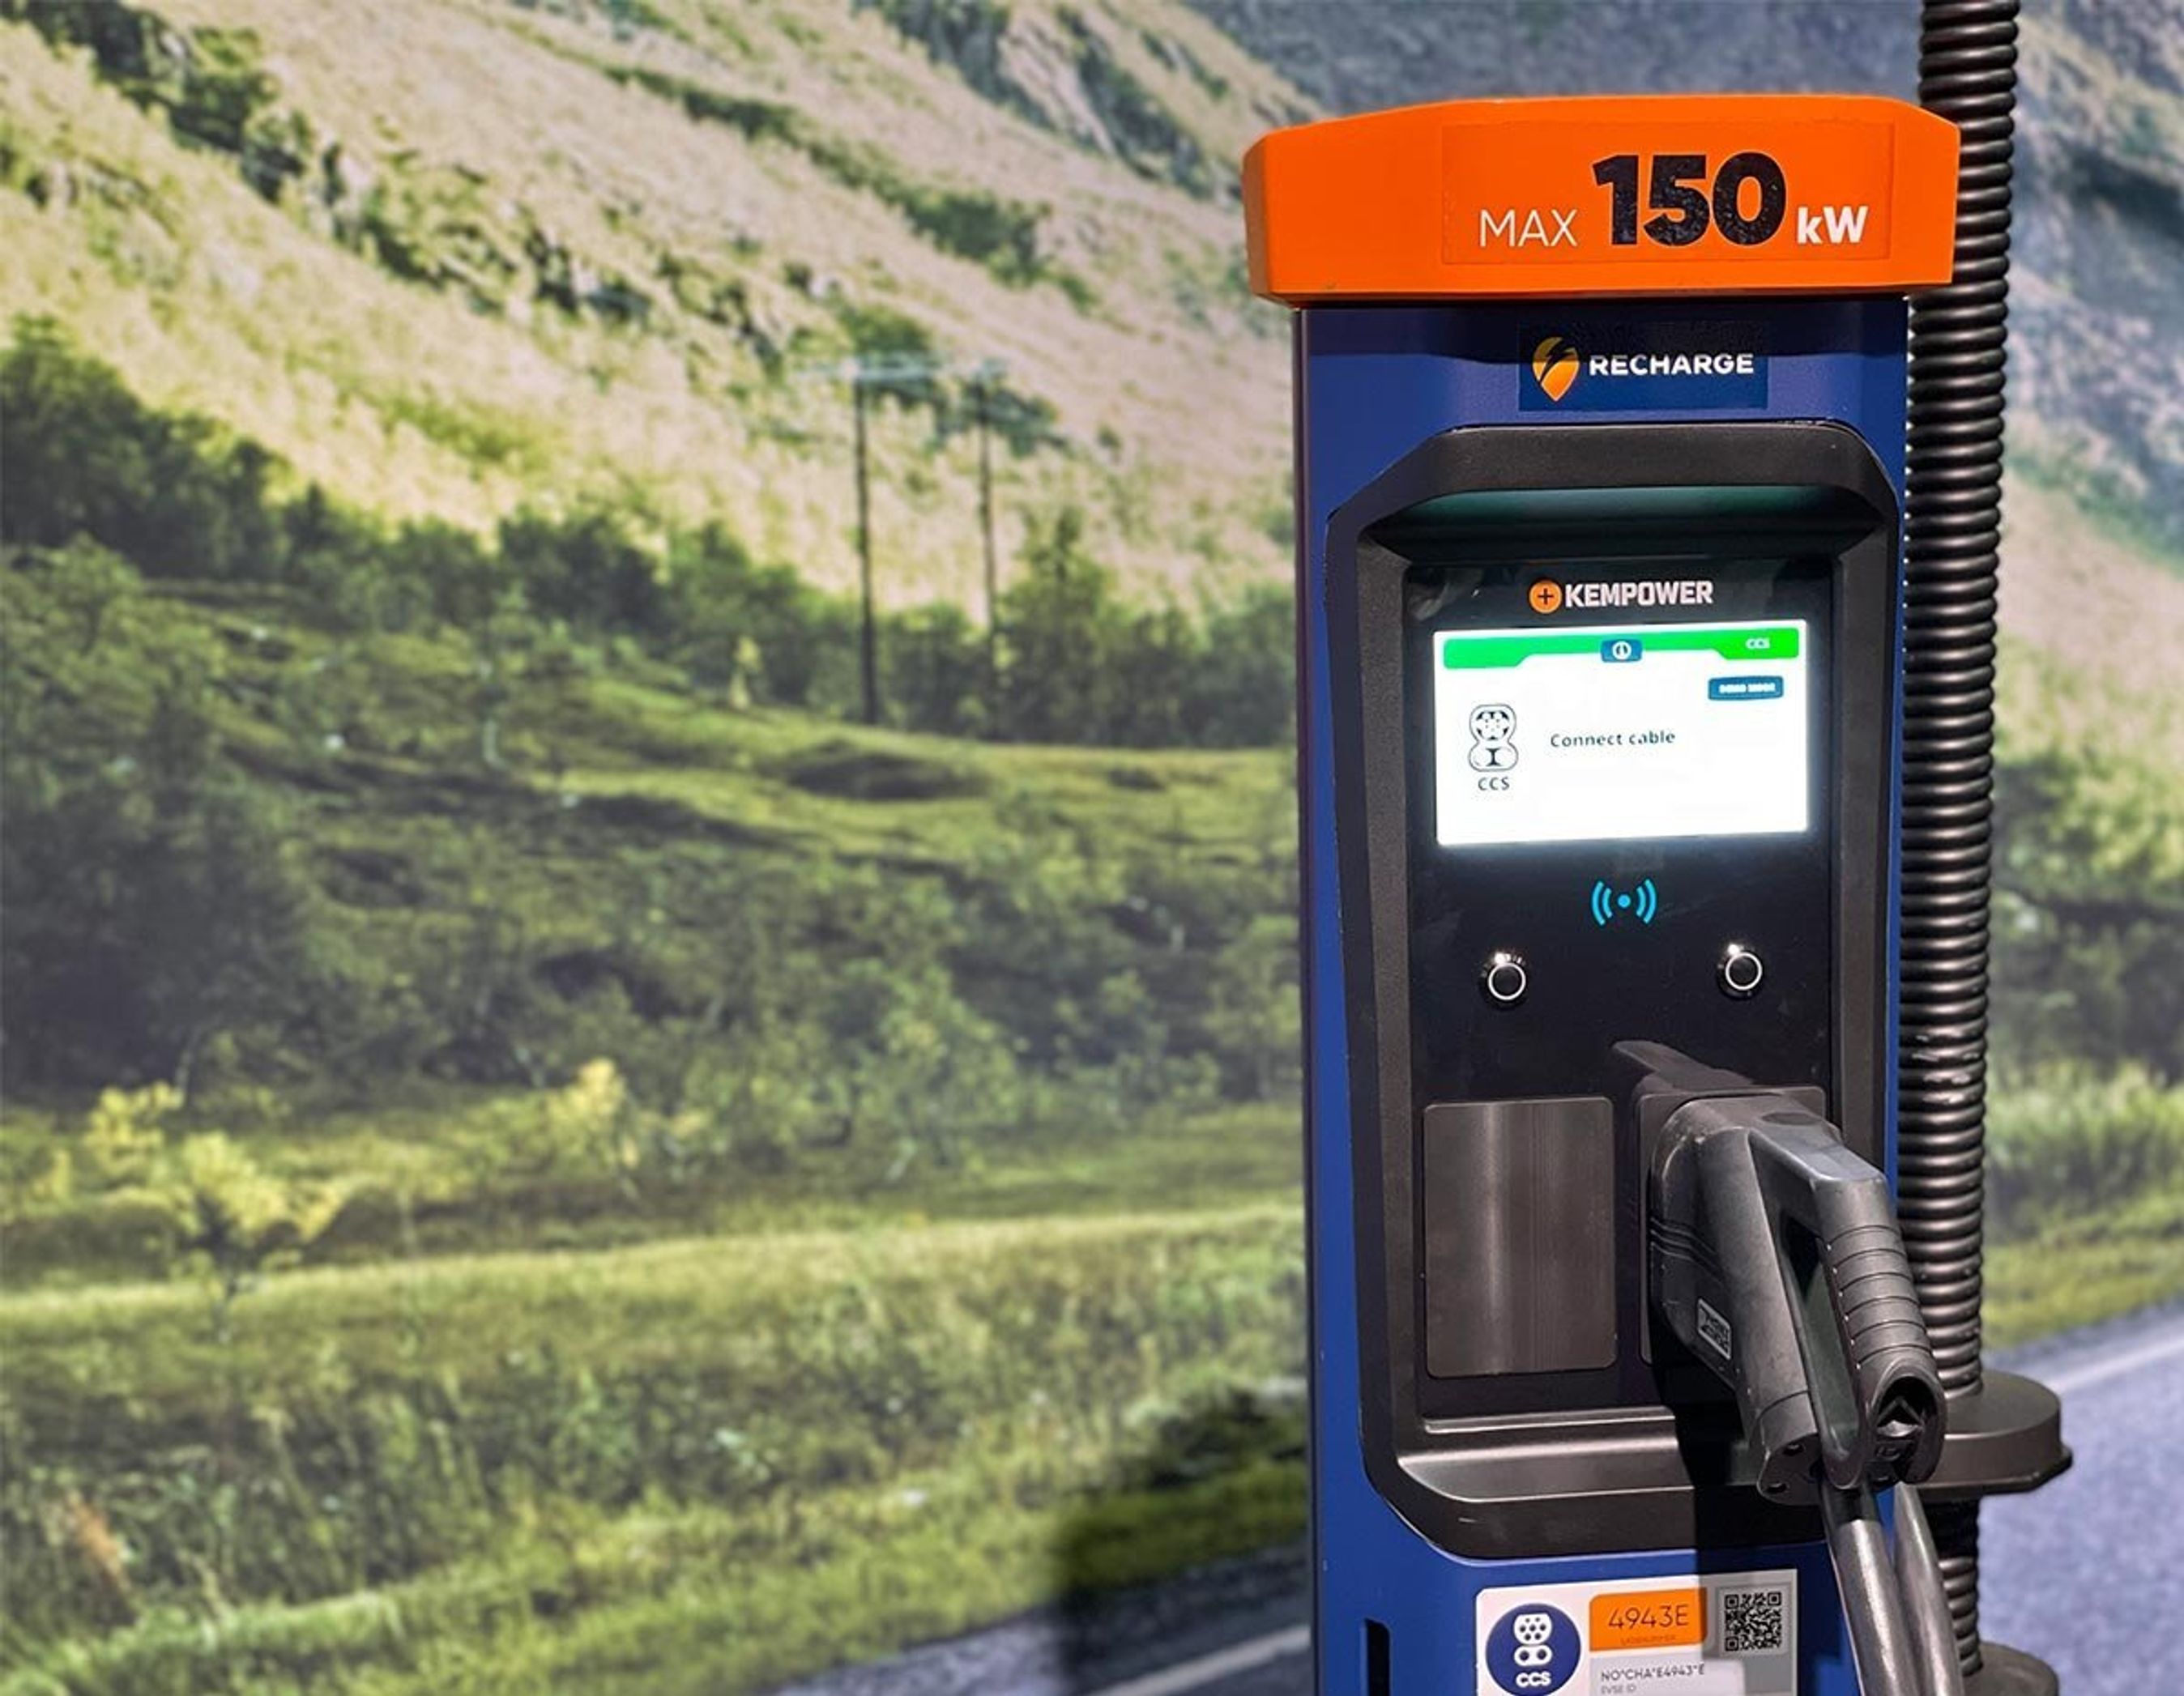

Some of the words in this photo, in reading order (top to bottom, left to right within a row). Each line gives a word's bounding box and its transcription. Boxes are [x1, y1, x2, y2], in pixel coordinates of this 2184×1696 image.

[1479, 209, 1577, 247] MAX
[1592, 151, 1786, 246] 150
[1796, 205, 1869, 244] kW
[1589, 352, 1754, 377] RECHARGE
[1564, 580, 1714, 608] KEMPOWER
[1550, 733, 1623, 748] Connect
[1628, 730, 1676, 746] cable
[1478, 776, 1510, 791] CCS
[1608, 1604, 1690, 1630] 4943E
[1516, 1670, 1552, 1687] CCS
